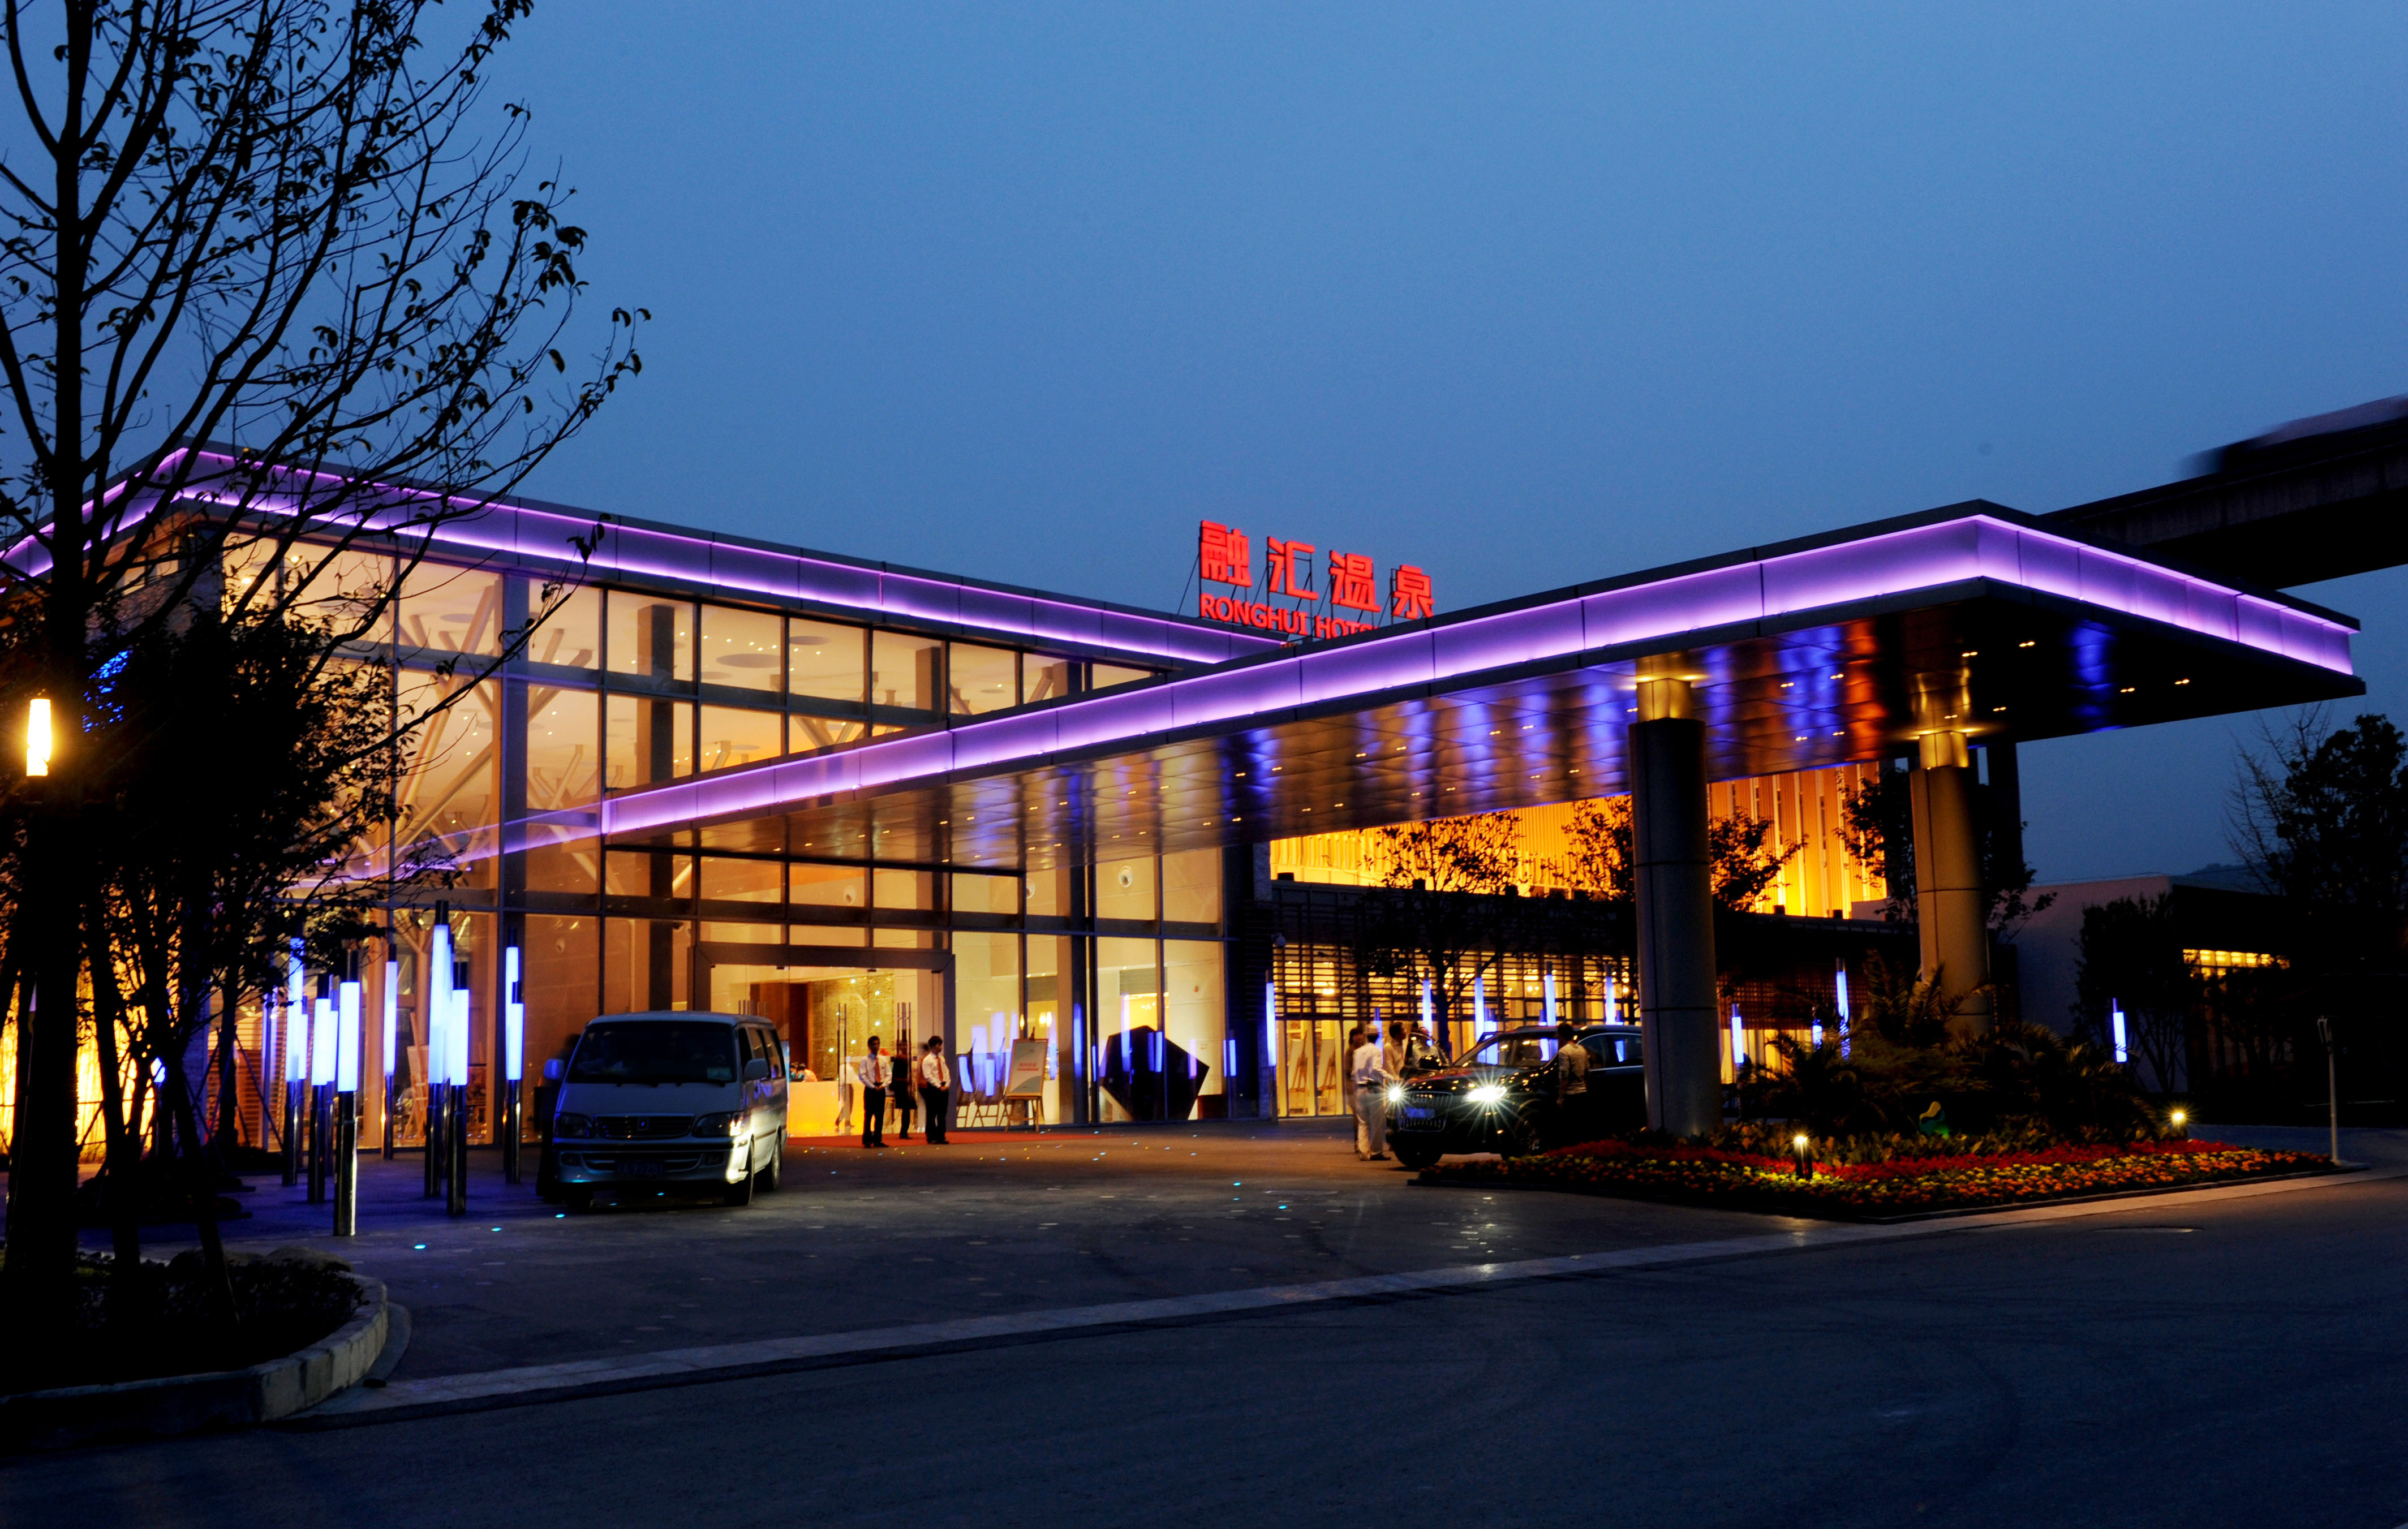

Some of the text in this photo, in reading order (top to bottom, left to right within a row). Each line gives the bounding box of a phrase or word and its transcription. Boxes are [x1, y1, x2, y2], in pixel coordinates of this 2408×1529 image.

[1201, 520, 1435, 620] 融汇温泉
[1200, 593, 1378, 640] RONGHUI HOT
